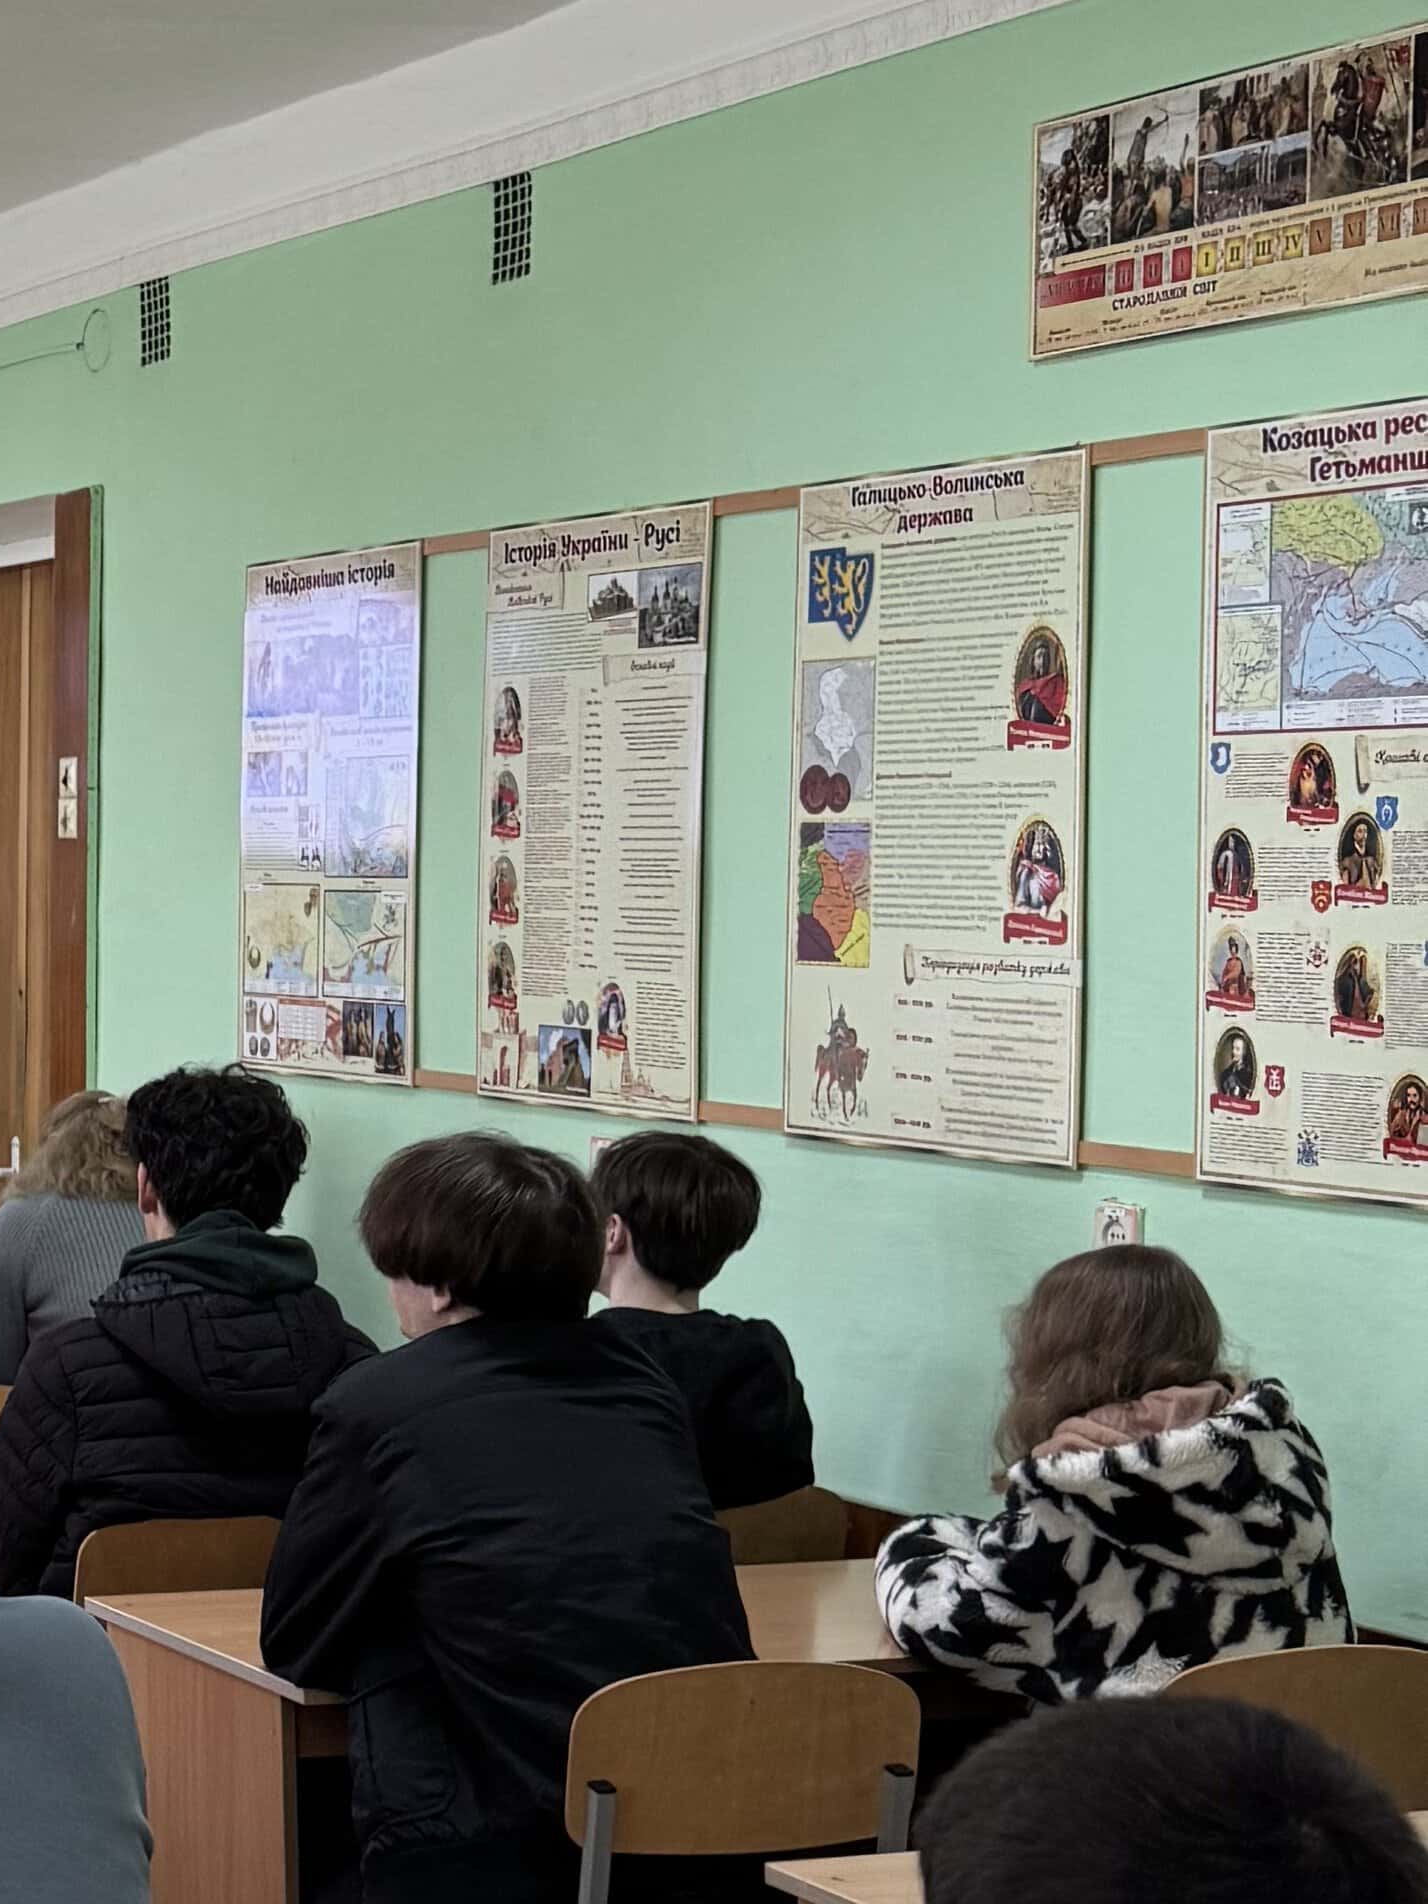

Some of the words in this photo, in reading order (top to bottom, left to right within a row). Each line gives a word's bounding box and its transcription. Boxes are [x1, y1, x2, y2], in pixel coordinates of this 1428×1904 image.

[1229, 246, 1241, 262] II
[1255, 239, 1272, 256] III
[1285, 234, 1302, 251] IV
[1262, 420, 1377, 454] Козацька
[897, 507, 974, 534] держава
[504, 537, 556, 567] Історія
[561, 529, 629, 561] України
[644, 520, 681, 552] Русі
[264, 568, 345, 597] Найдавніша
[348, 559, 396, 587] історія
